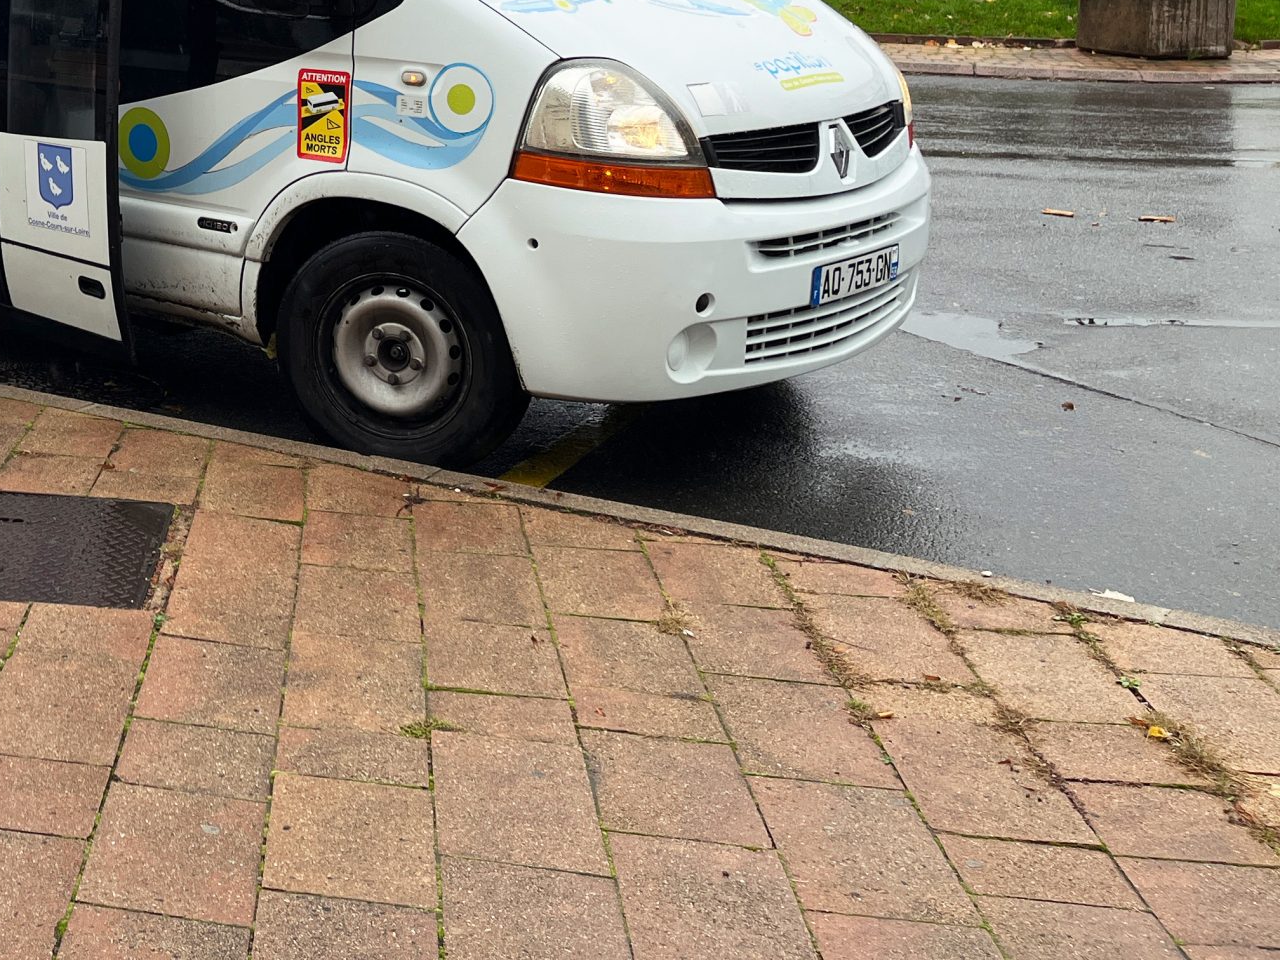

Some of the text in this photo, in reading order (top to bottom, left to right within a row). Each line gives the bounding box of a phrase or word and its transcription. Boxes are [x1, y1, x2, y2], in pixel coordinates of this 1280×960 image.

[762, 51, 832, 79] papillon
[302, 72, 346, 84] ATTENTION
[304, 132, 341, 145] ANGLES
[306, 143, 338, 155] MORTS
[47, 211, 67, 221] Ville de
